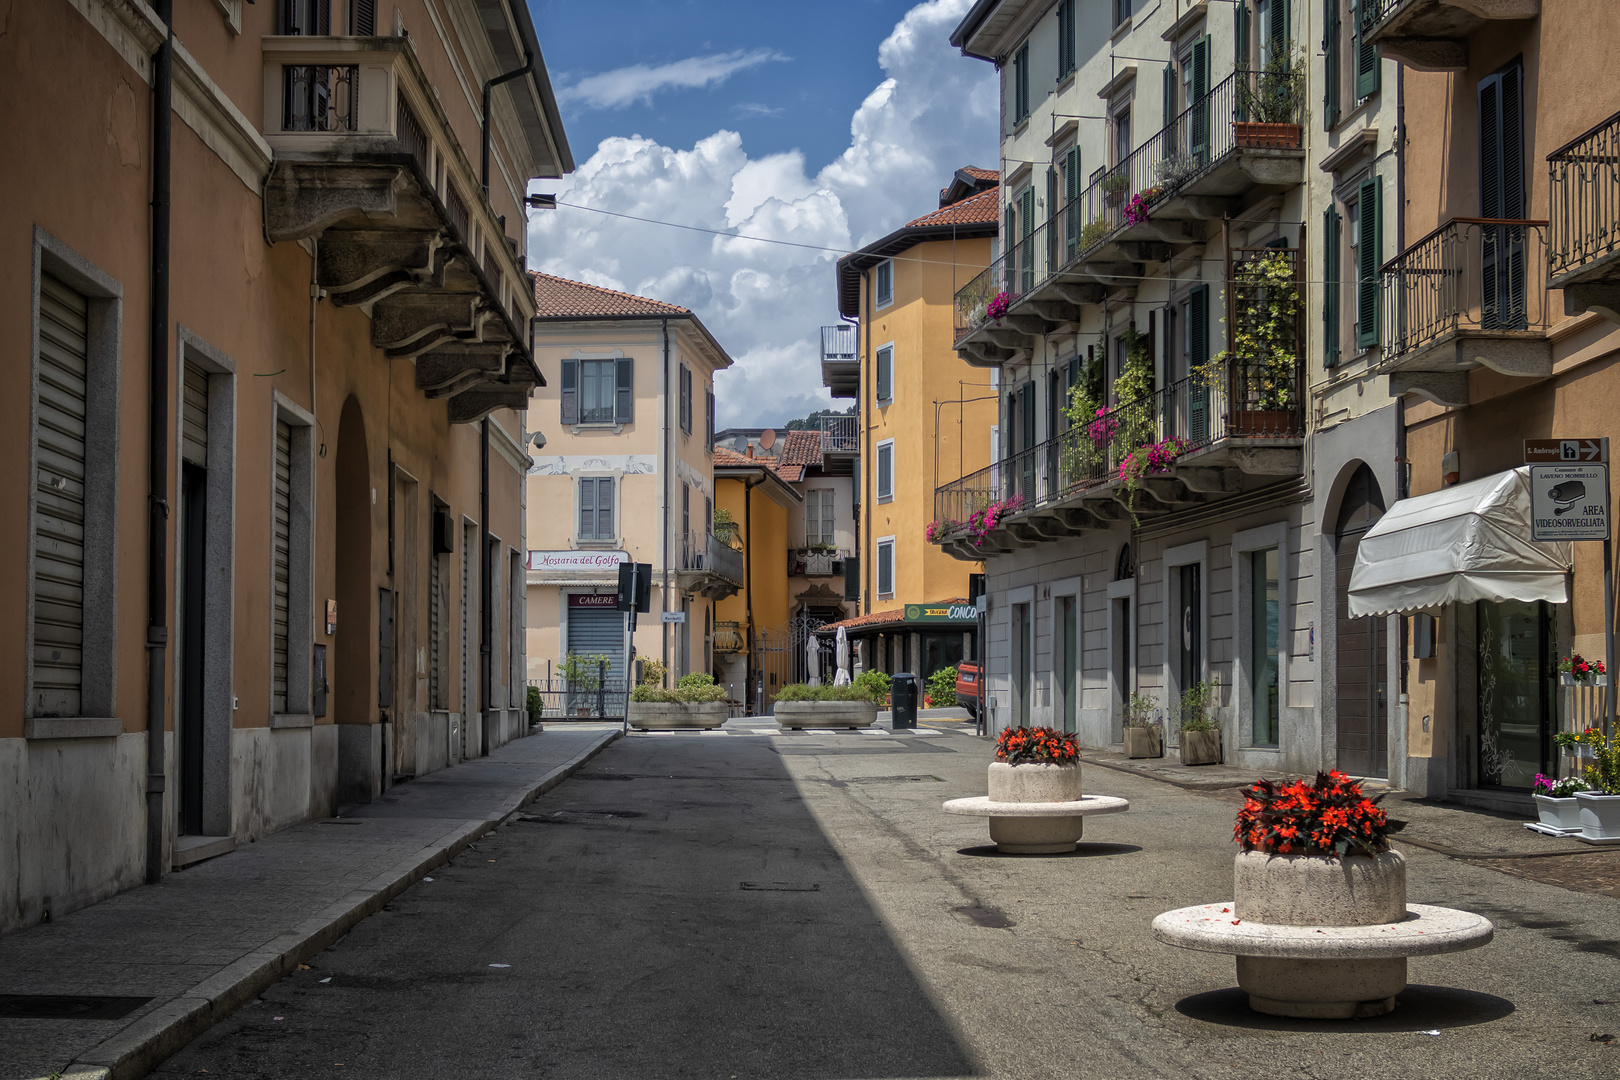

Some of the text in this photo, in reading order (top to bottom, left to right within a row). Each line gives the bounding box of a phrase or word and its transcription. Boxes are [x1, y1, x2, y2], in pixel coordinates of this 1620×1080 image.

[1582, 505, 1605, 516] AREA
[1535, 518, 1605, 528] VIDEOSORVEGLIATA
[537, 554, 620, 568] Hostaria del Golfo
[948, 605, 978, 619] CONCO
